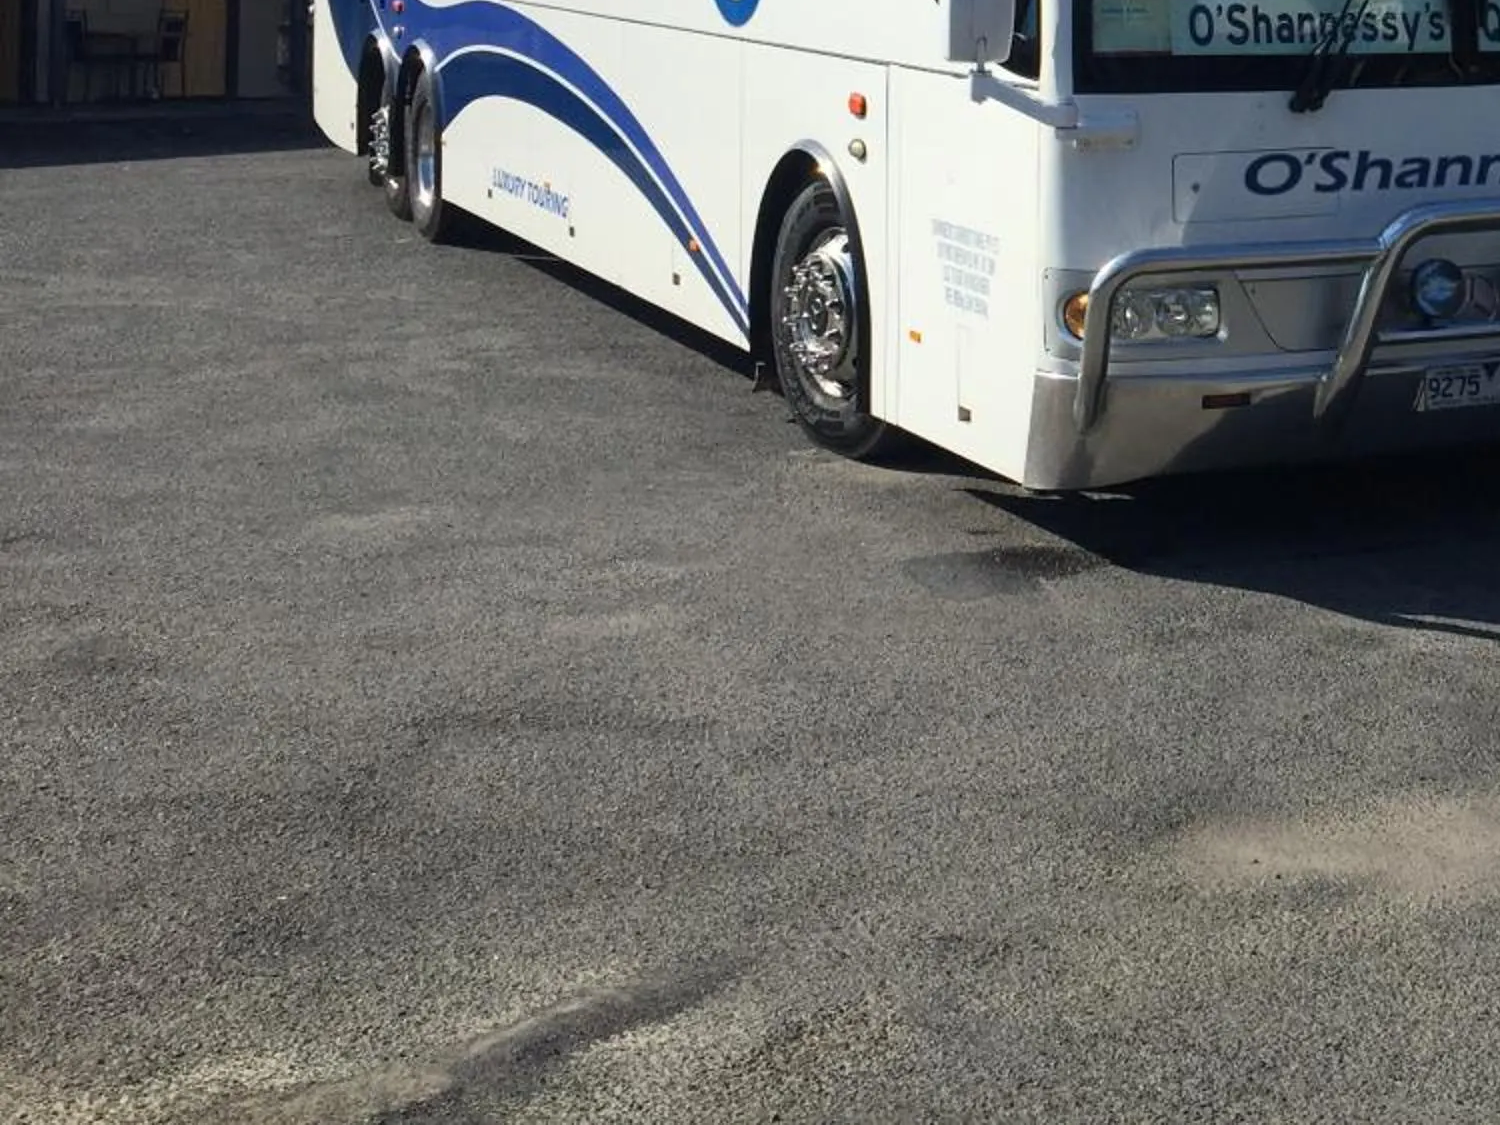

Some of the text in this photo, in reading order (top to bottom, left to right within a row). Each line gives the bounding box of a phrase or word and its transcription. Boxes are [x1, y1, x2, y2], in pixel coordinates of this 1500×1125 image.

[1189, 2, 1445, 51] O'Shannessy's
[493, 168, 568, 218] LUXURY TOURING
[1429, 374, 1480, 398] 9275
